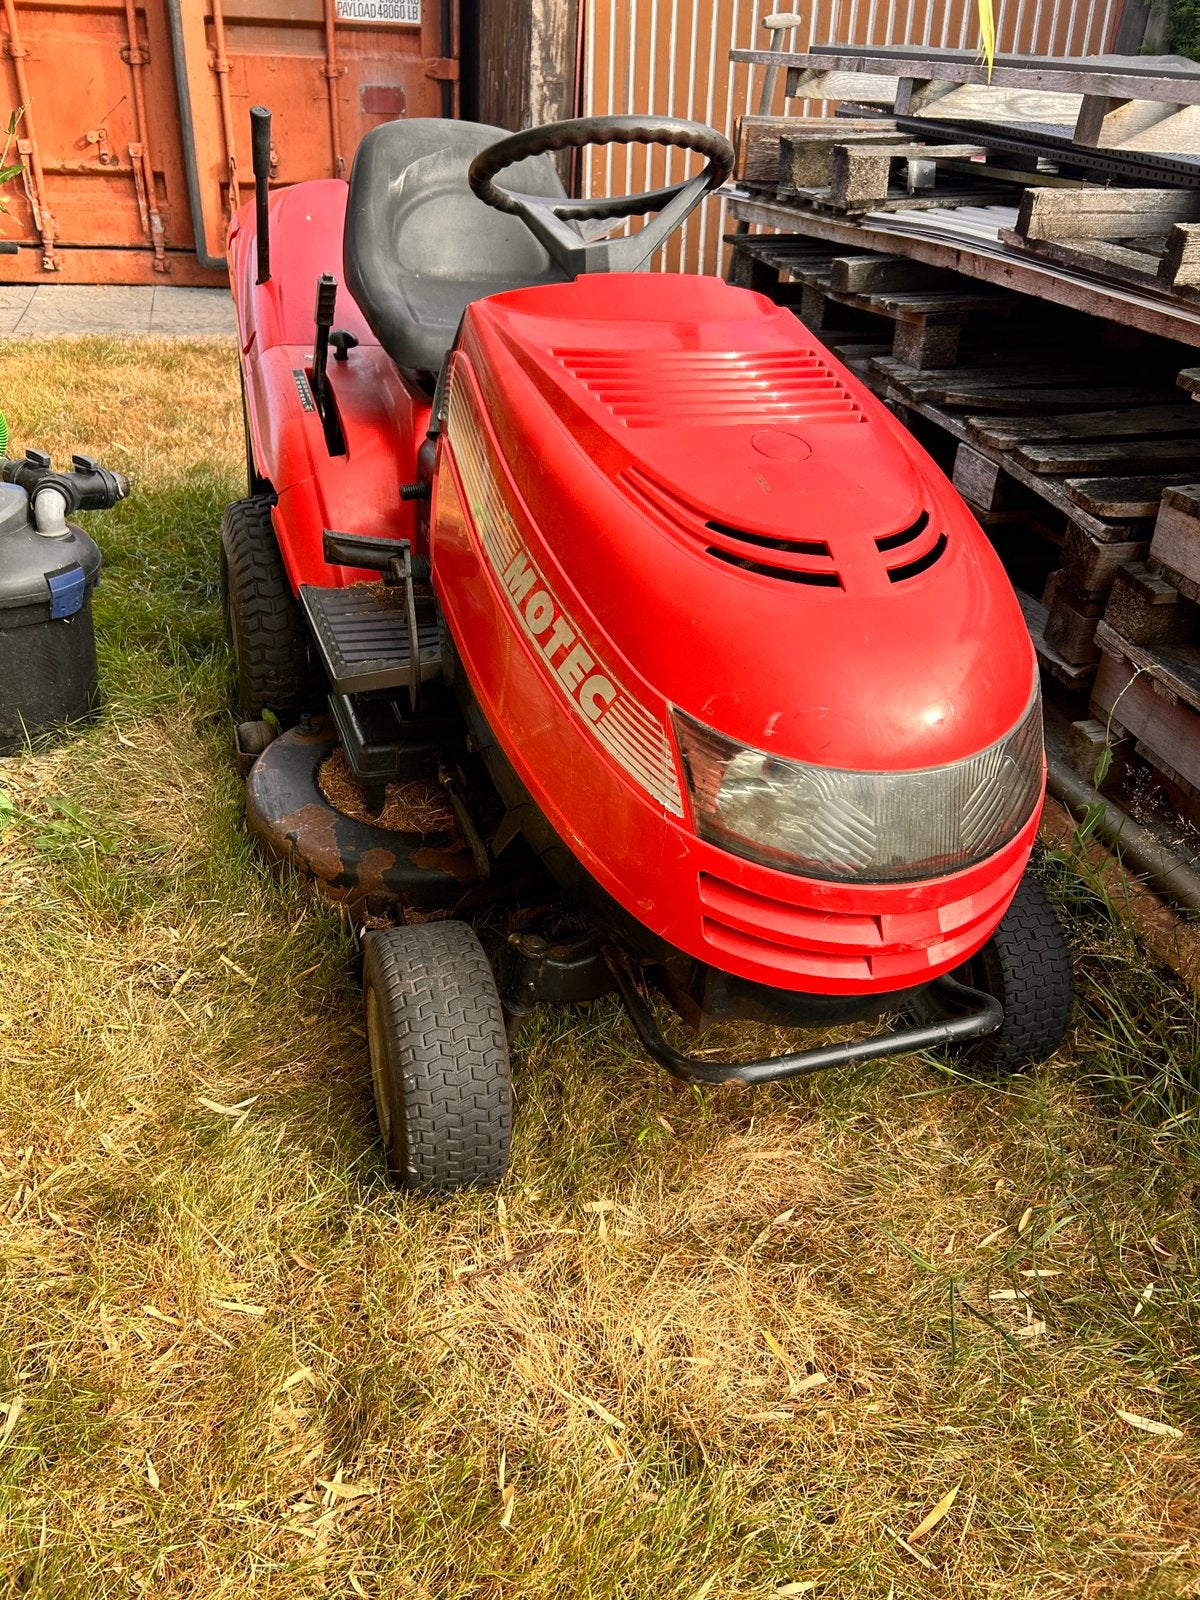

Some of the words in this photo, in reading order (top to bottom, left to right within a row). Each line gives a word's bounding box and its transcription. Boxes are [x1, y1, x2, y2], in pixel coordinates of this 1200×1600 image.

[337, 1, 376, 18] PAYLOAD
[377, 4, 405, 19] 48060
[408, 5, 418, 20] LB
[504, 550, 617, 721] MOTEC
